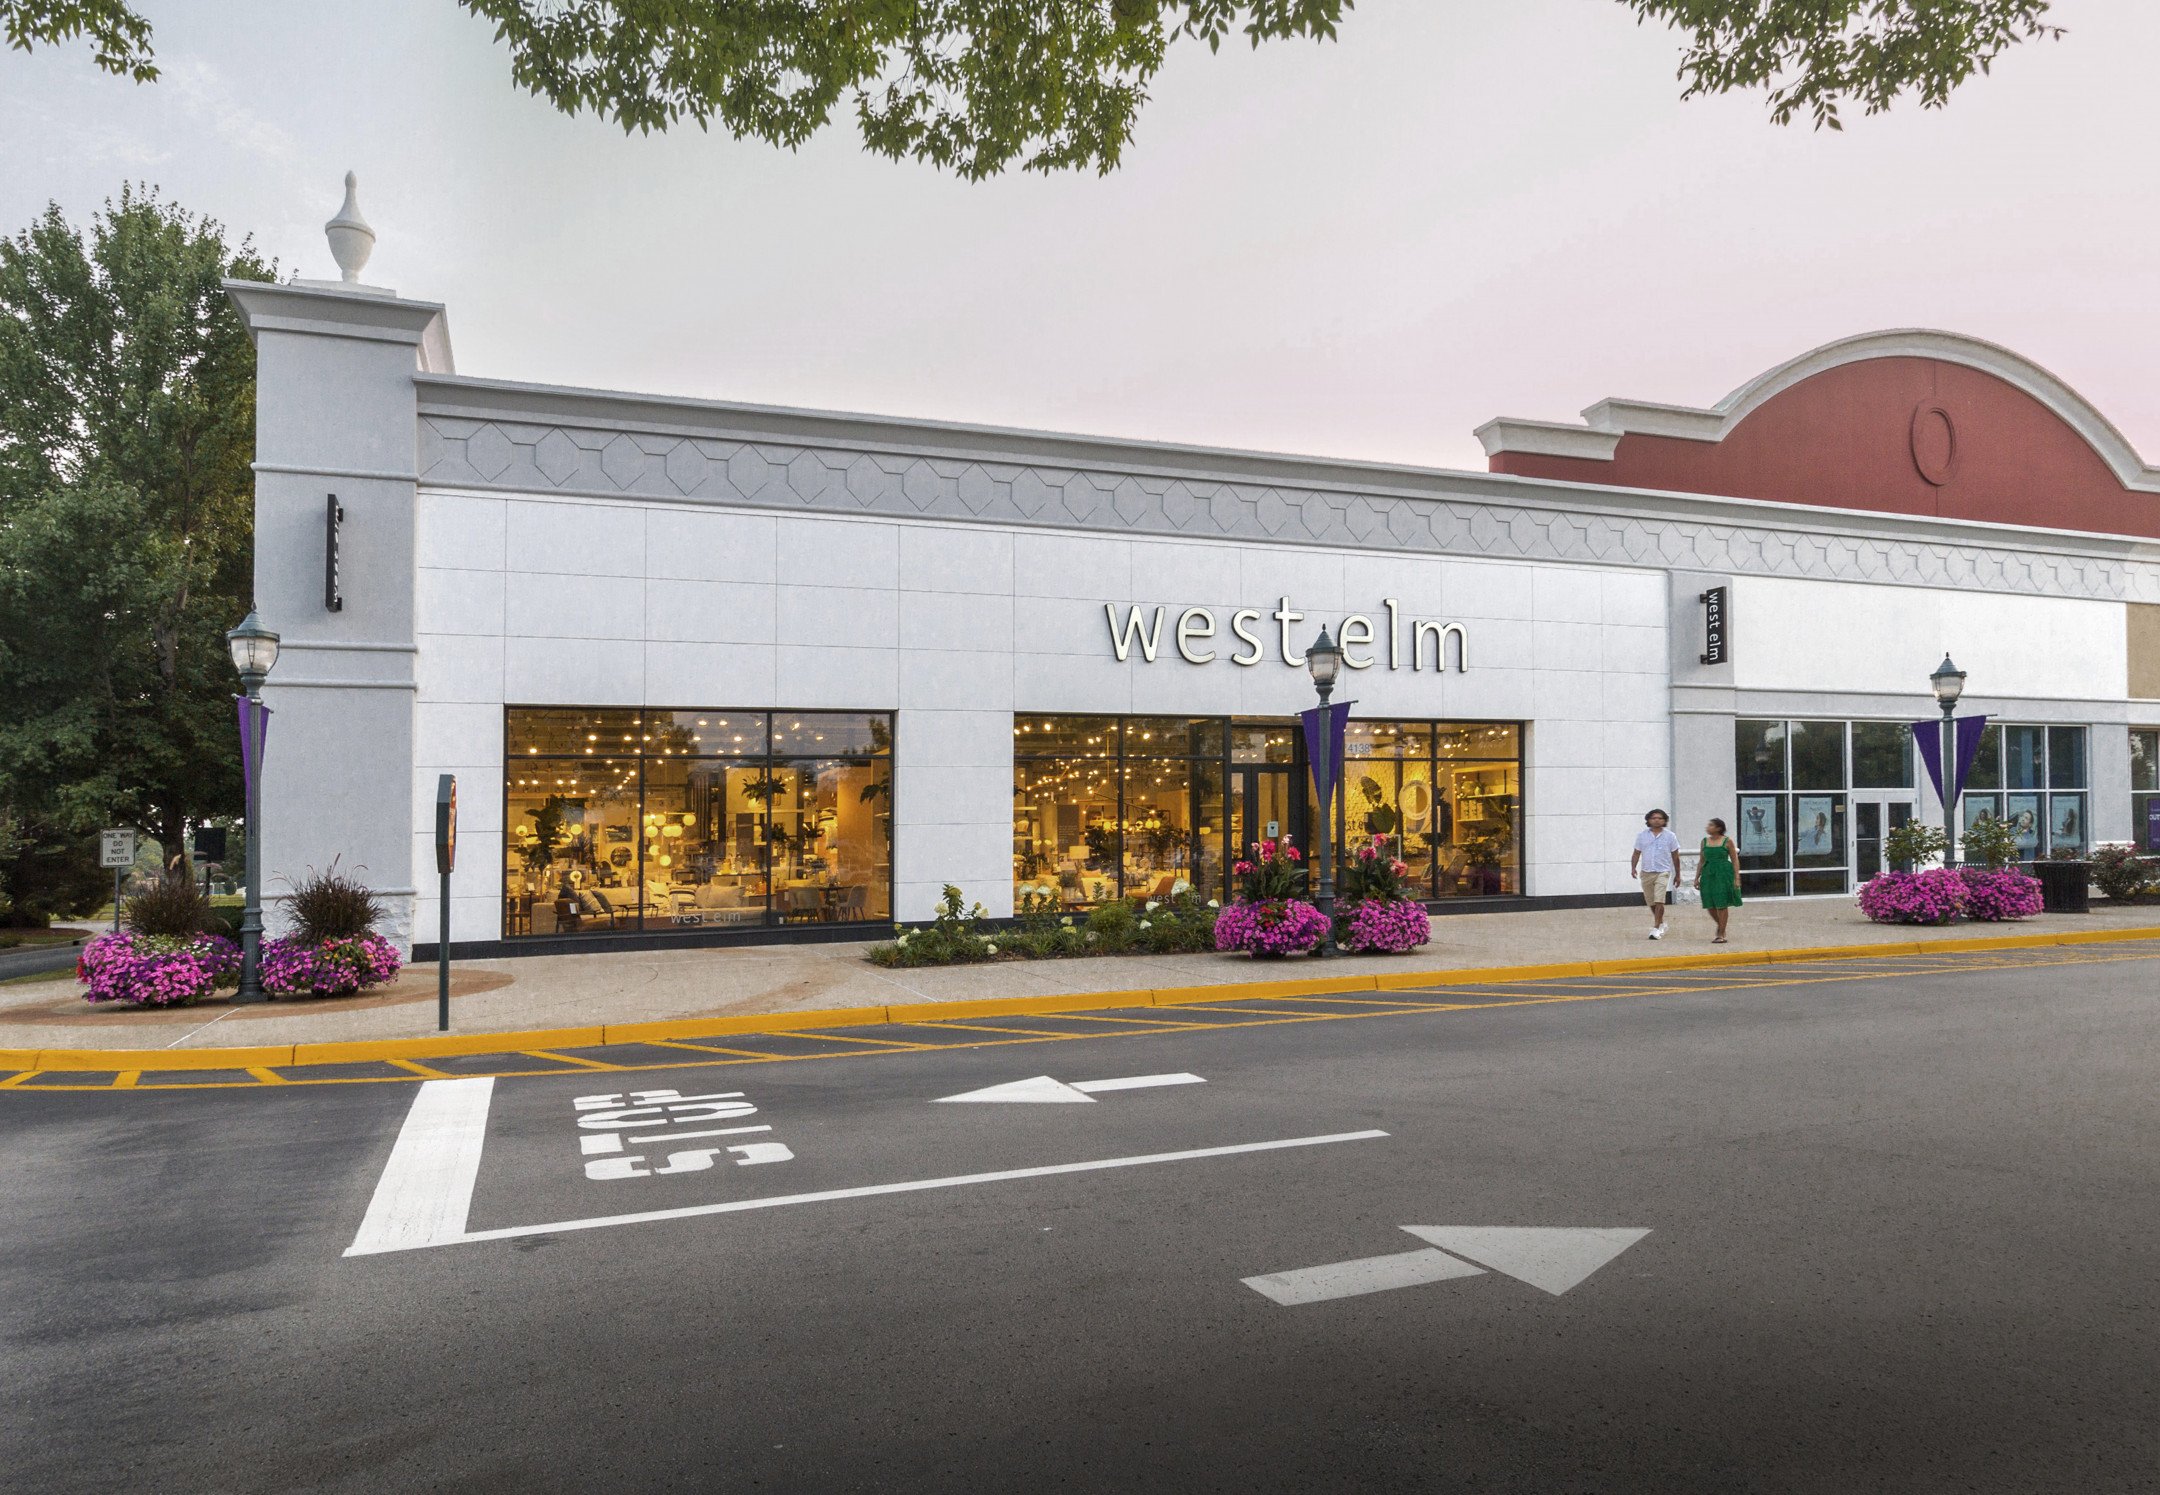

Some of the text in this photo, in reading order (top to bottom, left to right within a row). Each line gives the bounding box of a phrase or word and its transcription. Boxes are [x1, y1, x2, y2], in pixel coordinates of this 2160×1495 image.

[1105, 595, 1469, 673] west elm
[1709, 592, 1721, 661] west elm
[1348, 744, 1370, 753] 4138
[671, 911, 741, 924] west elm
[1147, 893, 1176, 904] west
[573, 1089, 795, 1181] STOP
